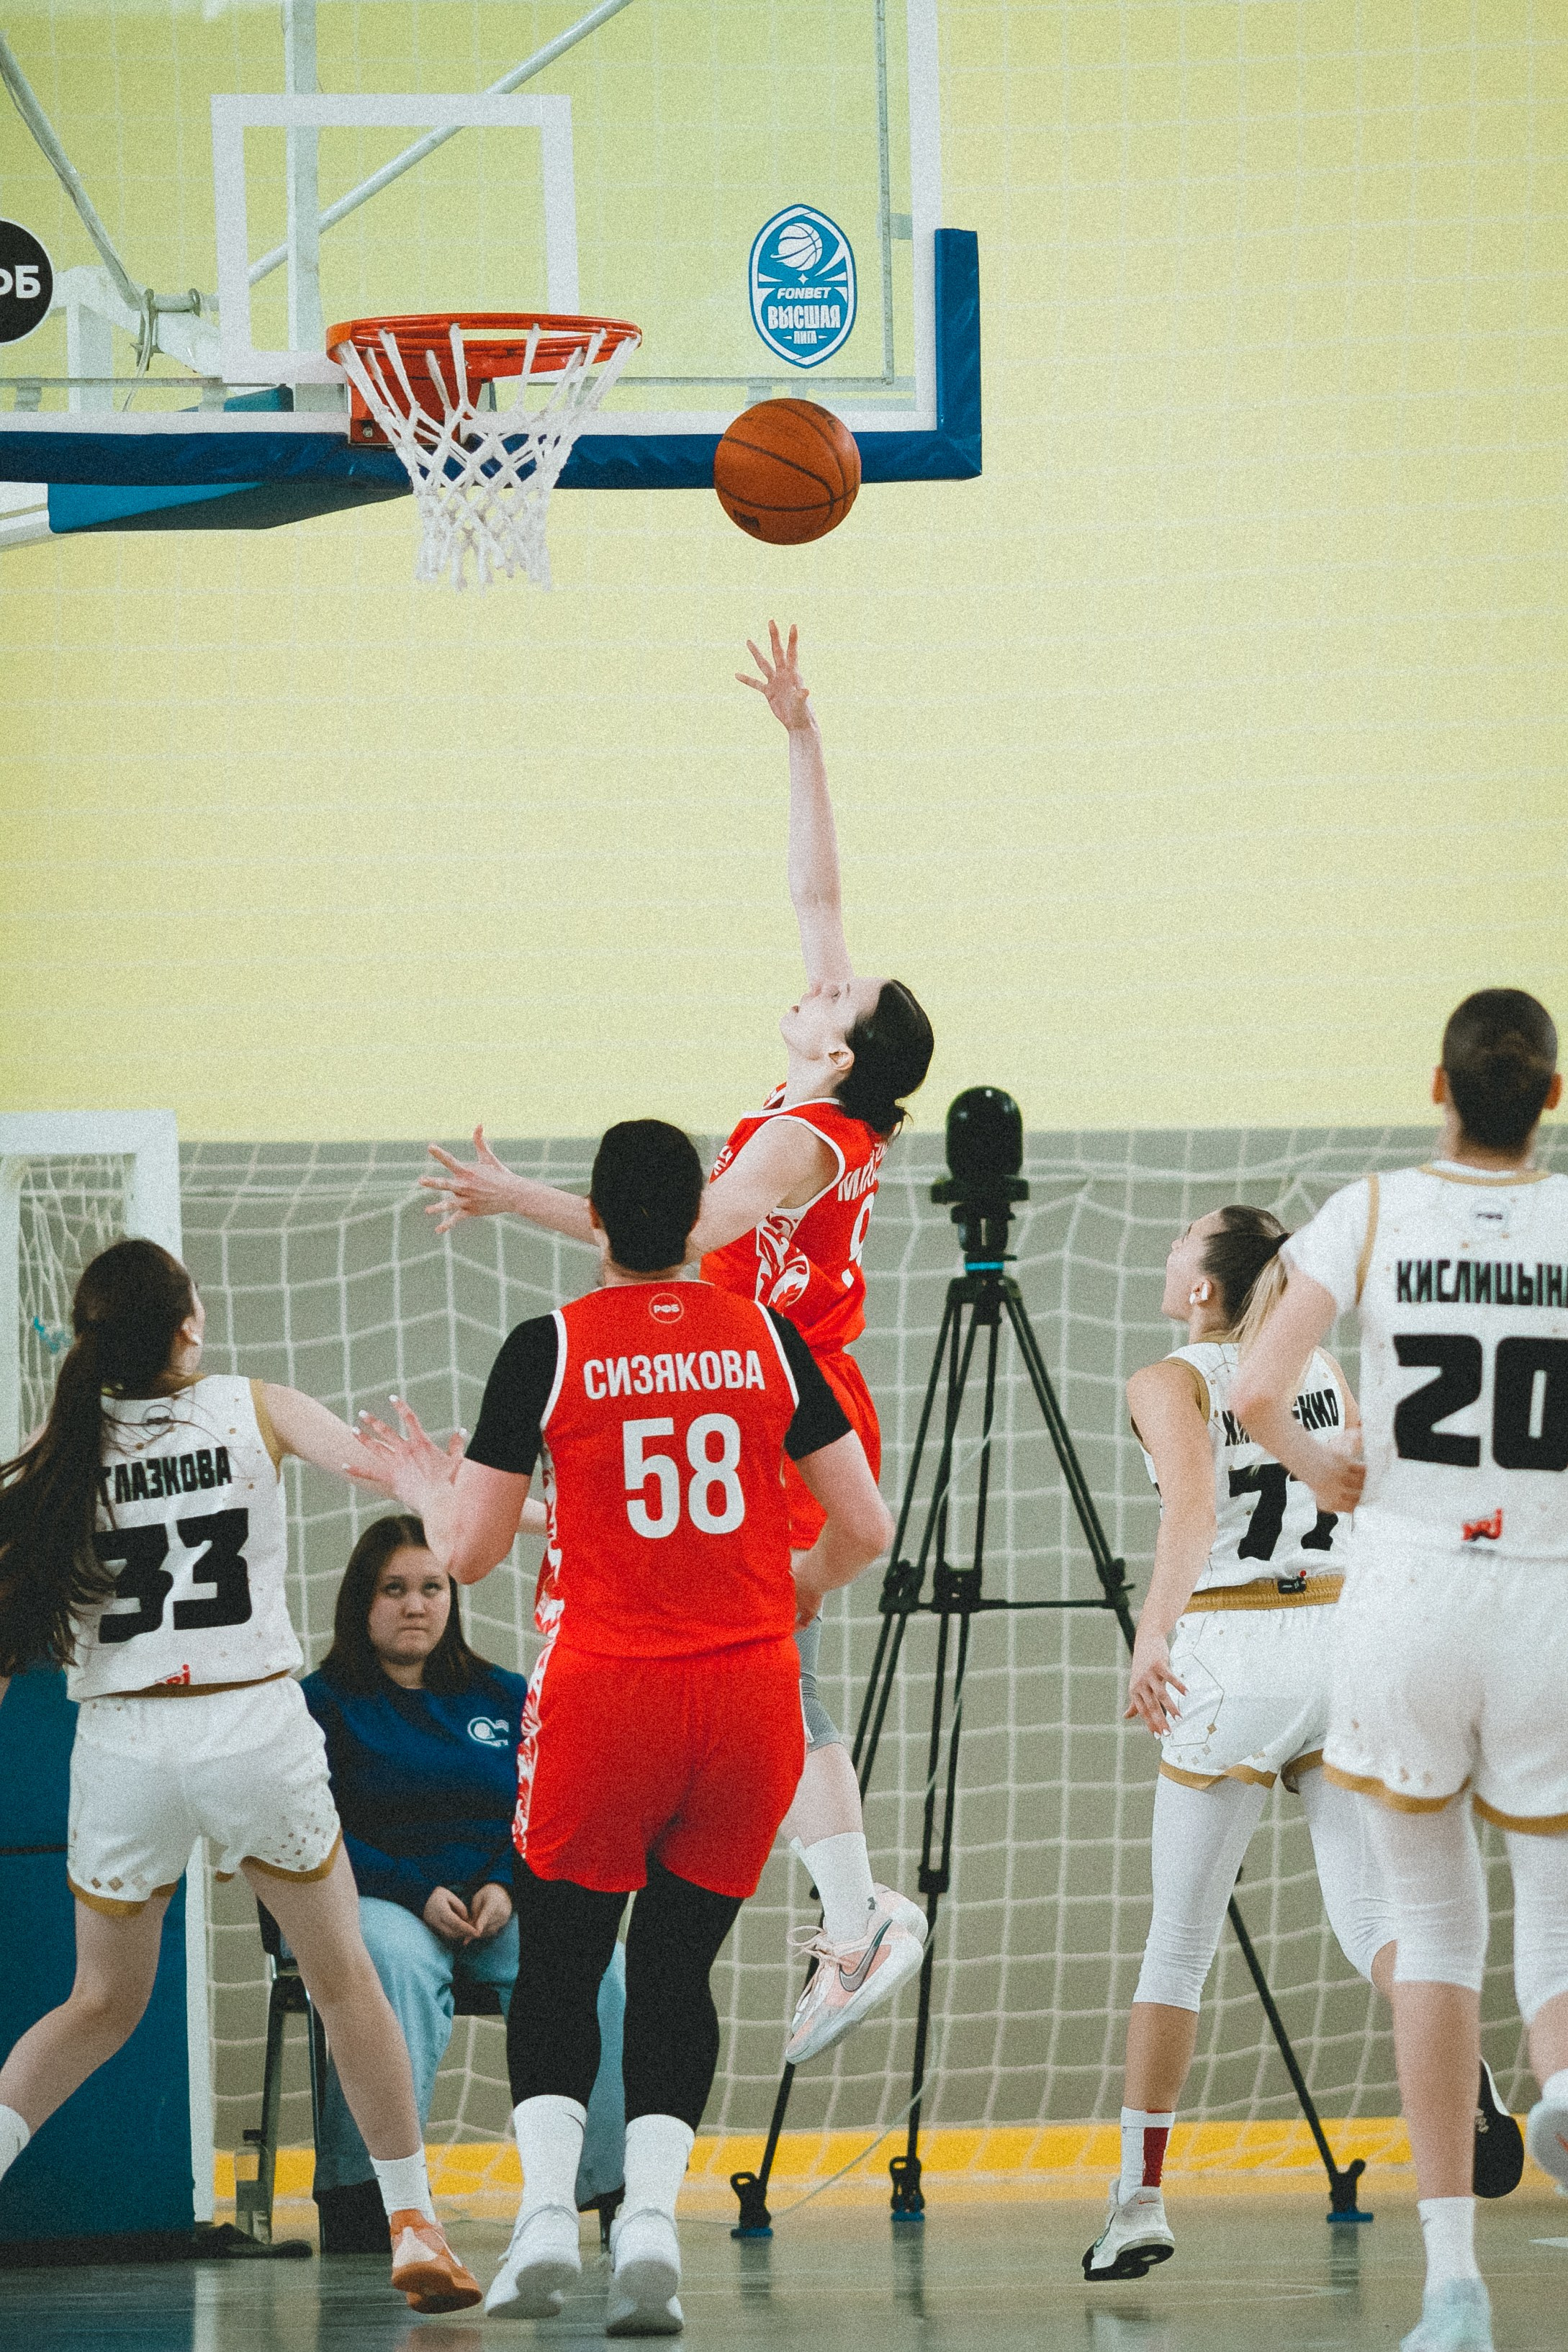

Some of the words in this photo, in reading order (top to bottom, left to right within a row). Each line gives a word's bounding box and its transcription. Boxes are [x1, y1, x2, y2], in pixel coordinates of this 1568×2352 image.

[767, 305, 841, 330] ВЫСШАЯ
[777, 287, 832, 299] FONBET
[1397, 1259, 1568, 1308] КИСЛИЦЫН
[583, 1349, 766, 1400] СИЗЯКОВА
[1393, 1333, 1568, 1472] 20
[622, 1412, 746, 1539] 58
[92, 1508, 253, 1644] 33
